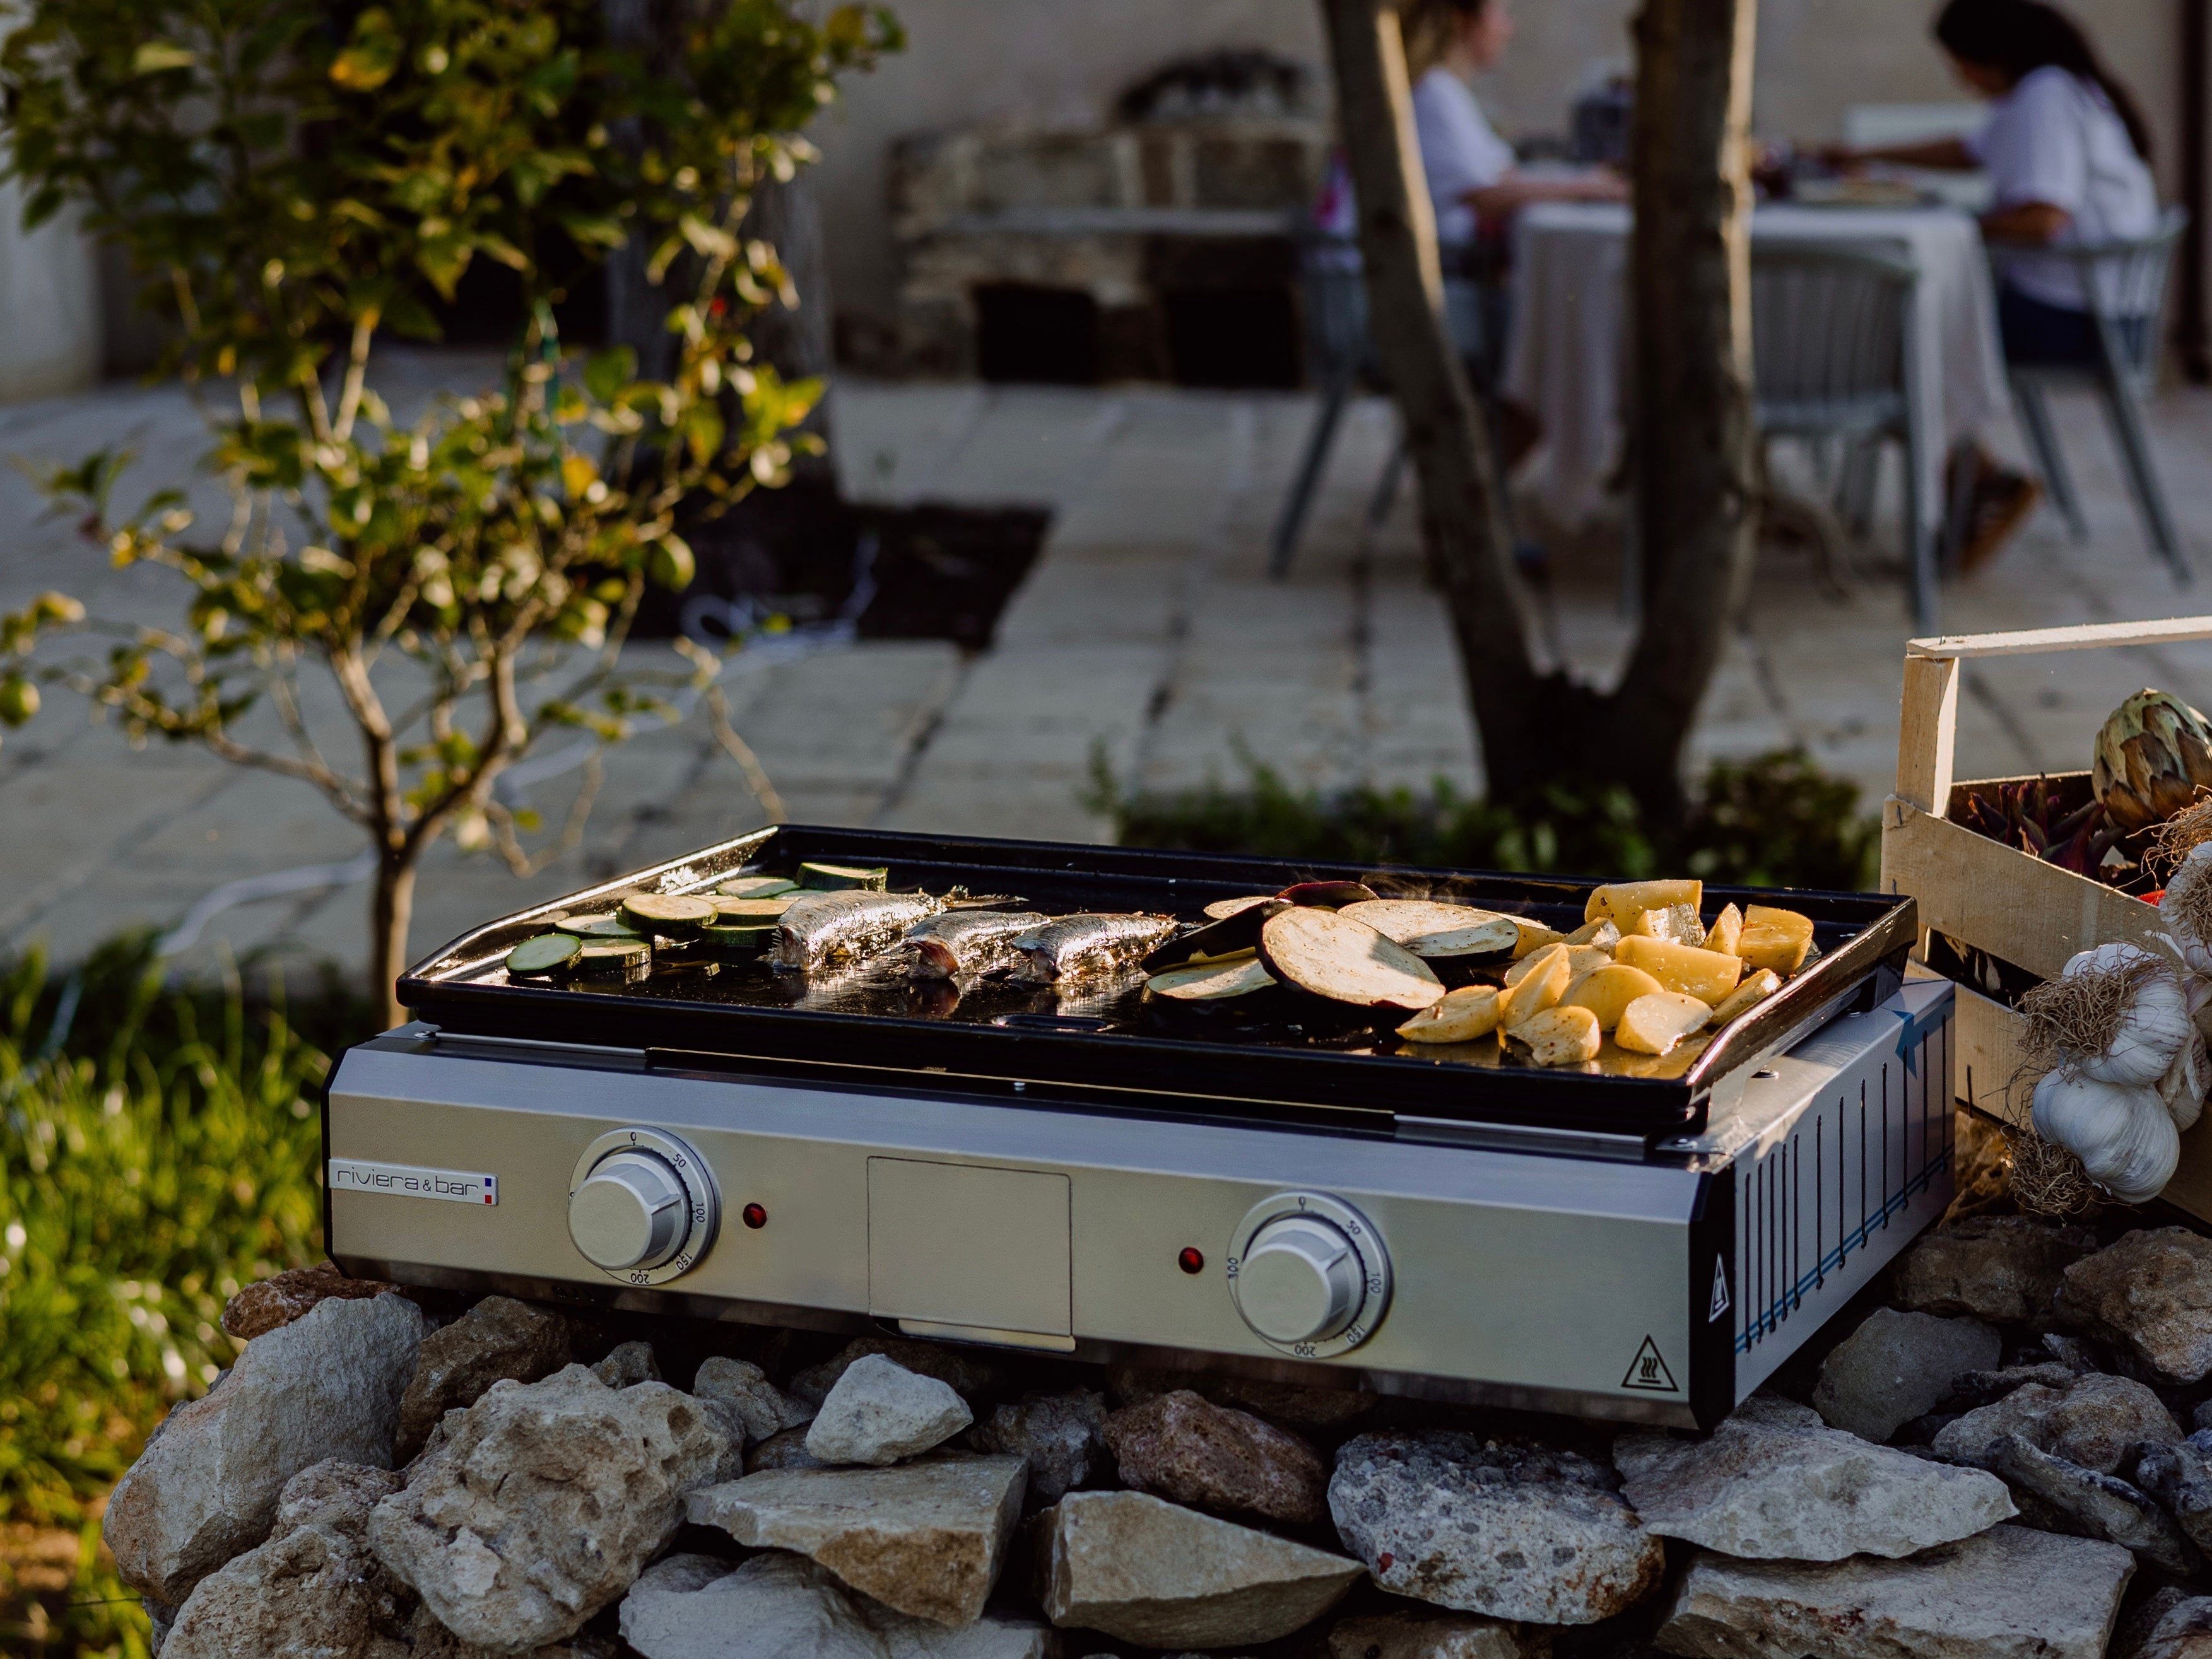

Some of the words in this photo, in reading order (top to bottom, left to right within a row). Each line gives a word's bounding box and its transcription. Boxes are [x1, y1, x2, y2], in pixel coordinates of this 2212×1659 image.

[630, 1132, 637, 1142] 0
[673, 1153, 686, 1168] 50
[695, 1202, 705, 1223] 100
[1346, 1220, 1362, 1235] 50
[676, 1252, 692, 1271] 150
[630, 1273, 650, 1284] 200
[1370, 1272, 1381, 1294] 100
[1346, 1325, 1365, 1344] 150
[1294, 1345, 1316, 1357] 200
